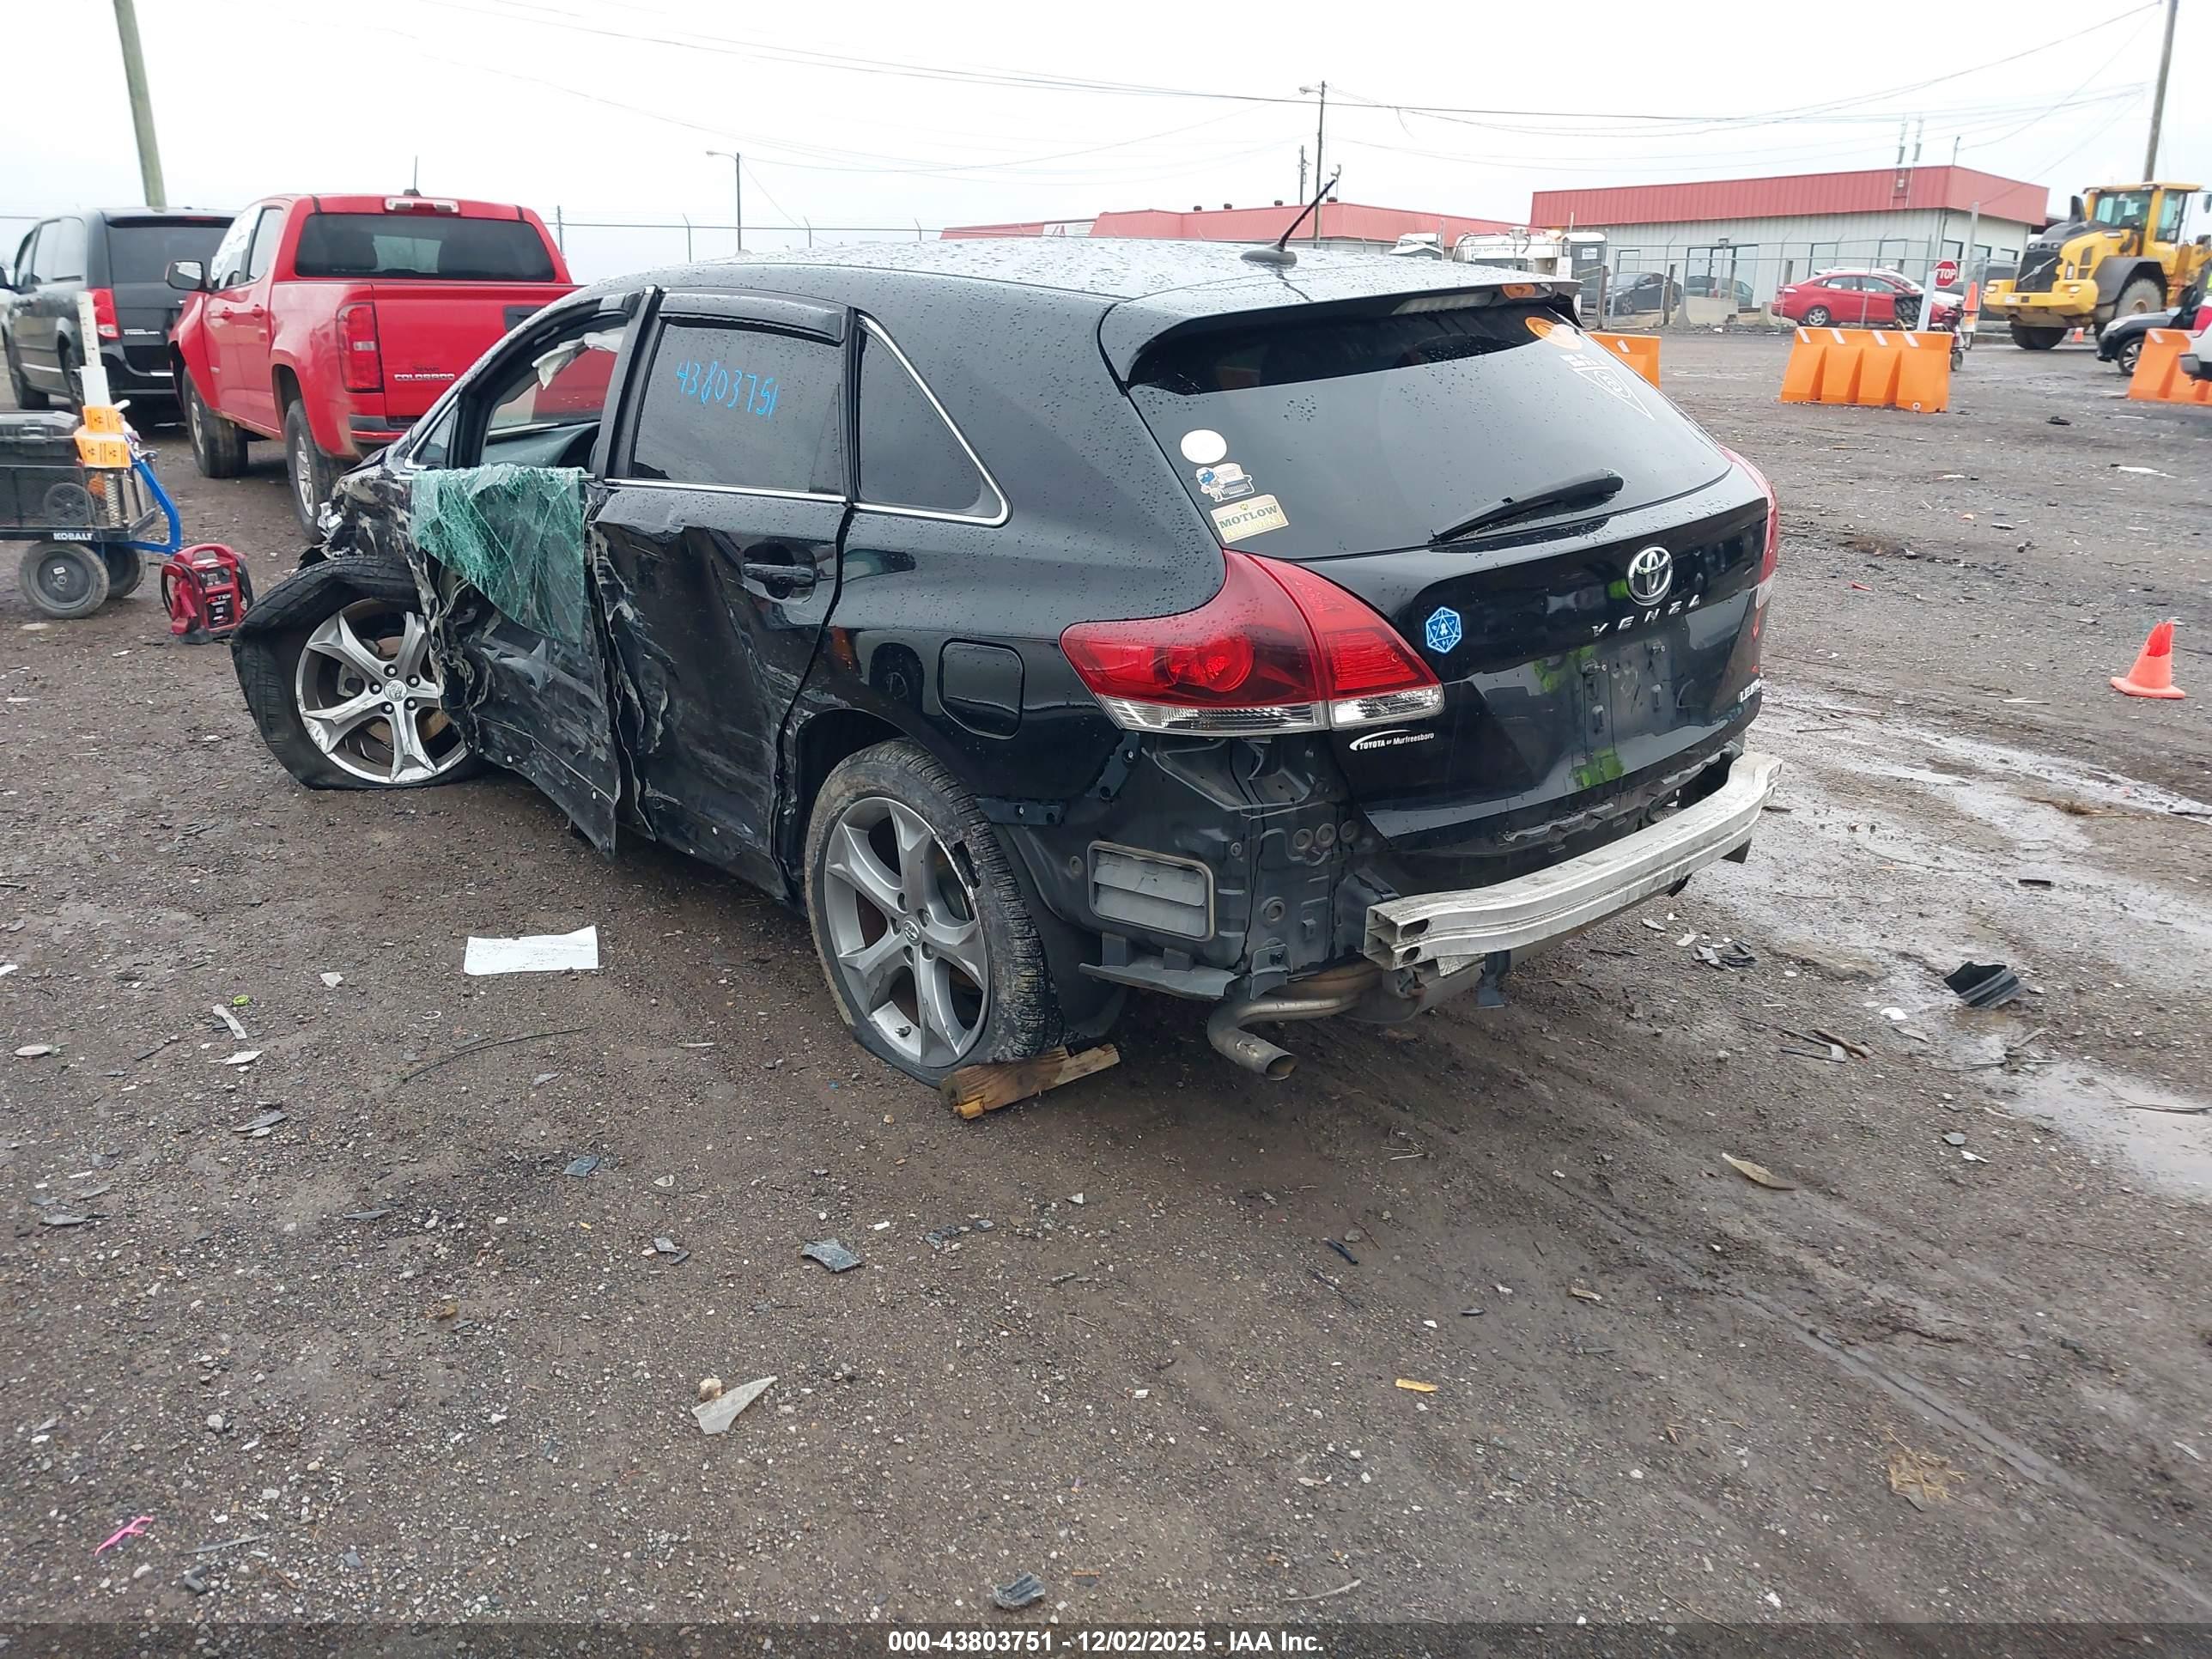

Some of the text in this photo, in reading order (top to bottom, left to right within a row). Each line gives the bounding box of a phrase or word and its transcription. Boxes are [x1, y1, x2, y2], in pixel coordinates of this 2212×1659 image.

[677, 358, 779, 419] 43803751
[1218, 505, 1278, 528] MOTLOW
[53, 532, 93, 541] KOBALT
[1591, 594, 1700, 636] VENZA
[1359, 739, 1386, 750] TOYOTA
[1393, 732, 1435, 745] Murfreesboro
